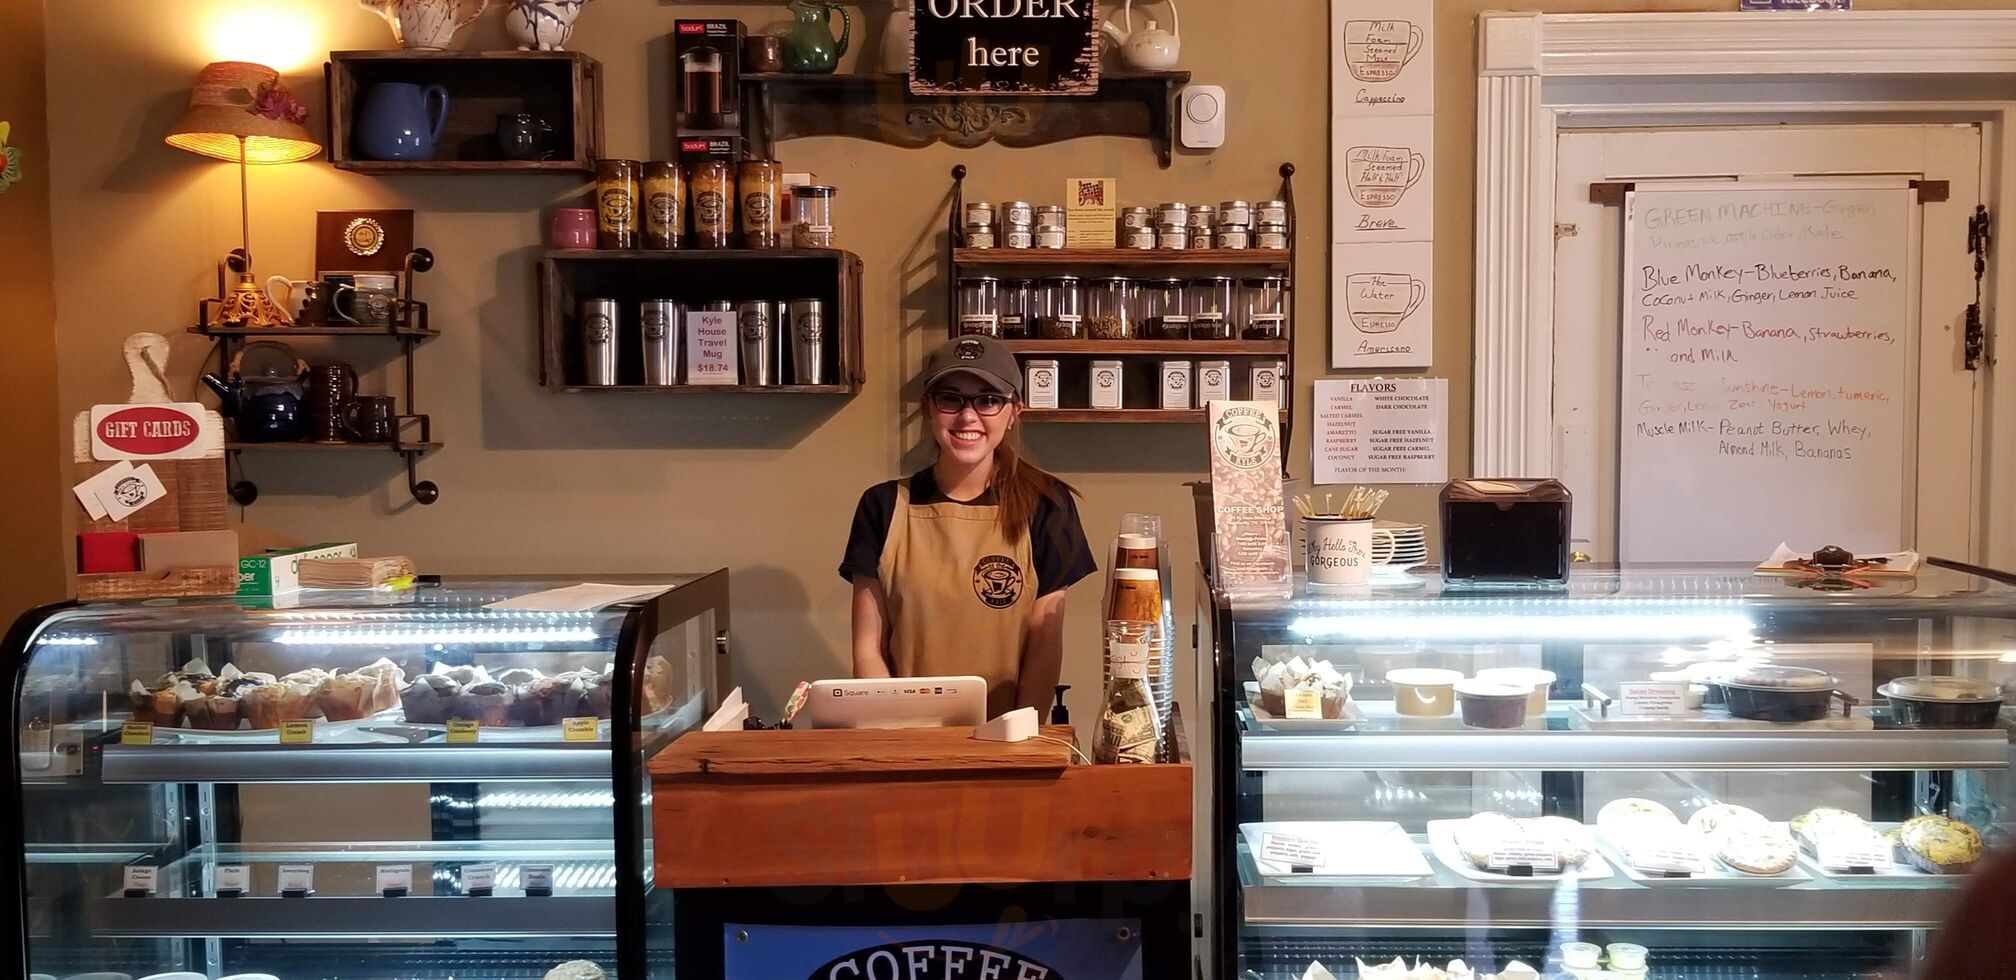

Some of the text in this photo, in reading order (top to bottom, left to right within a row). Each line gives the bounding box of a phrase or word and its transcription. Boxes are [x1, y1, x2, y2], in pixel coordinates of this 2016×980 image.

[927, 0, 1080, 18] ORDER
[968, 37, 1040, 67] here
[1354, 214, 1398, 228] Breve
[1645, 206, 1713, 230] GREEN
[1641, 265, 1681, 291] Blue
[1838, 265, 1897, 283] Banana,
[1360, 288, 1395, 300] Water
[1778, 288, 1817, 301] Lemon
[1820, 286, 1859, 300] Juice
[702, 316, 723, 326] Kyle
[698, 327, 727, 336] House
[1642, 315, 1671, 342] Red
[698, 338, 728, 347] Travel
[1357, 340, 1412, 353] Americano
[703, 350, 723, 359] Mug
[697, 364, 729, 373] $18.74
[1350, 383, 1397, 393] FLAVORS
[1225, 407, 1263, 419] COFFEE
[105, 420, 192, 438] GIFT CARDS
[1636, 422, 1675, 438] Muscle
[1719, 418, 1765, 436] Peanut
[1794, 443, 1852, 460] Bananas
[1236, 457, 1257, 466] KYLE
[1217, 506, 1285, 514] COFFEE SHOP
[1322, 536, 1347, 551] Hello
[240, 559, 267, 568] GC-12
[1310, 555, 1360, 569] GORGEOUS
[844, 689, 869, 697] Square
[828, 945, 1050, 980] COFFEE
